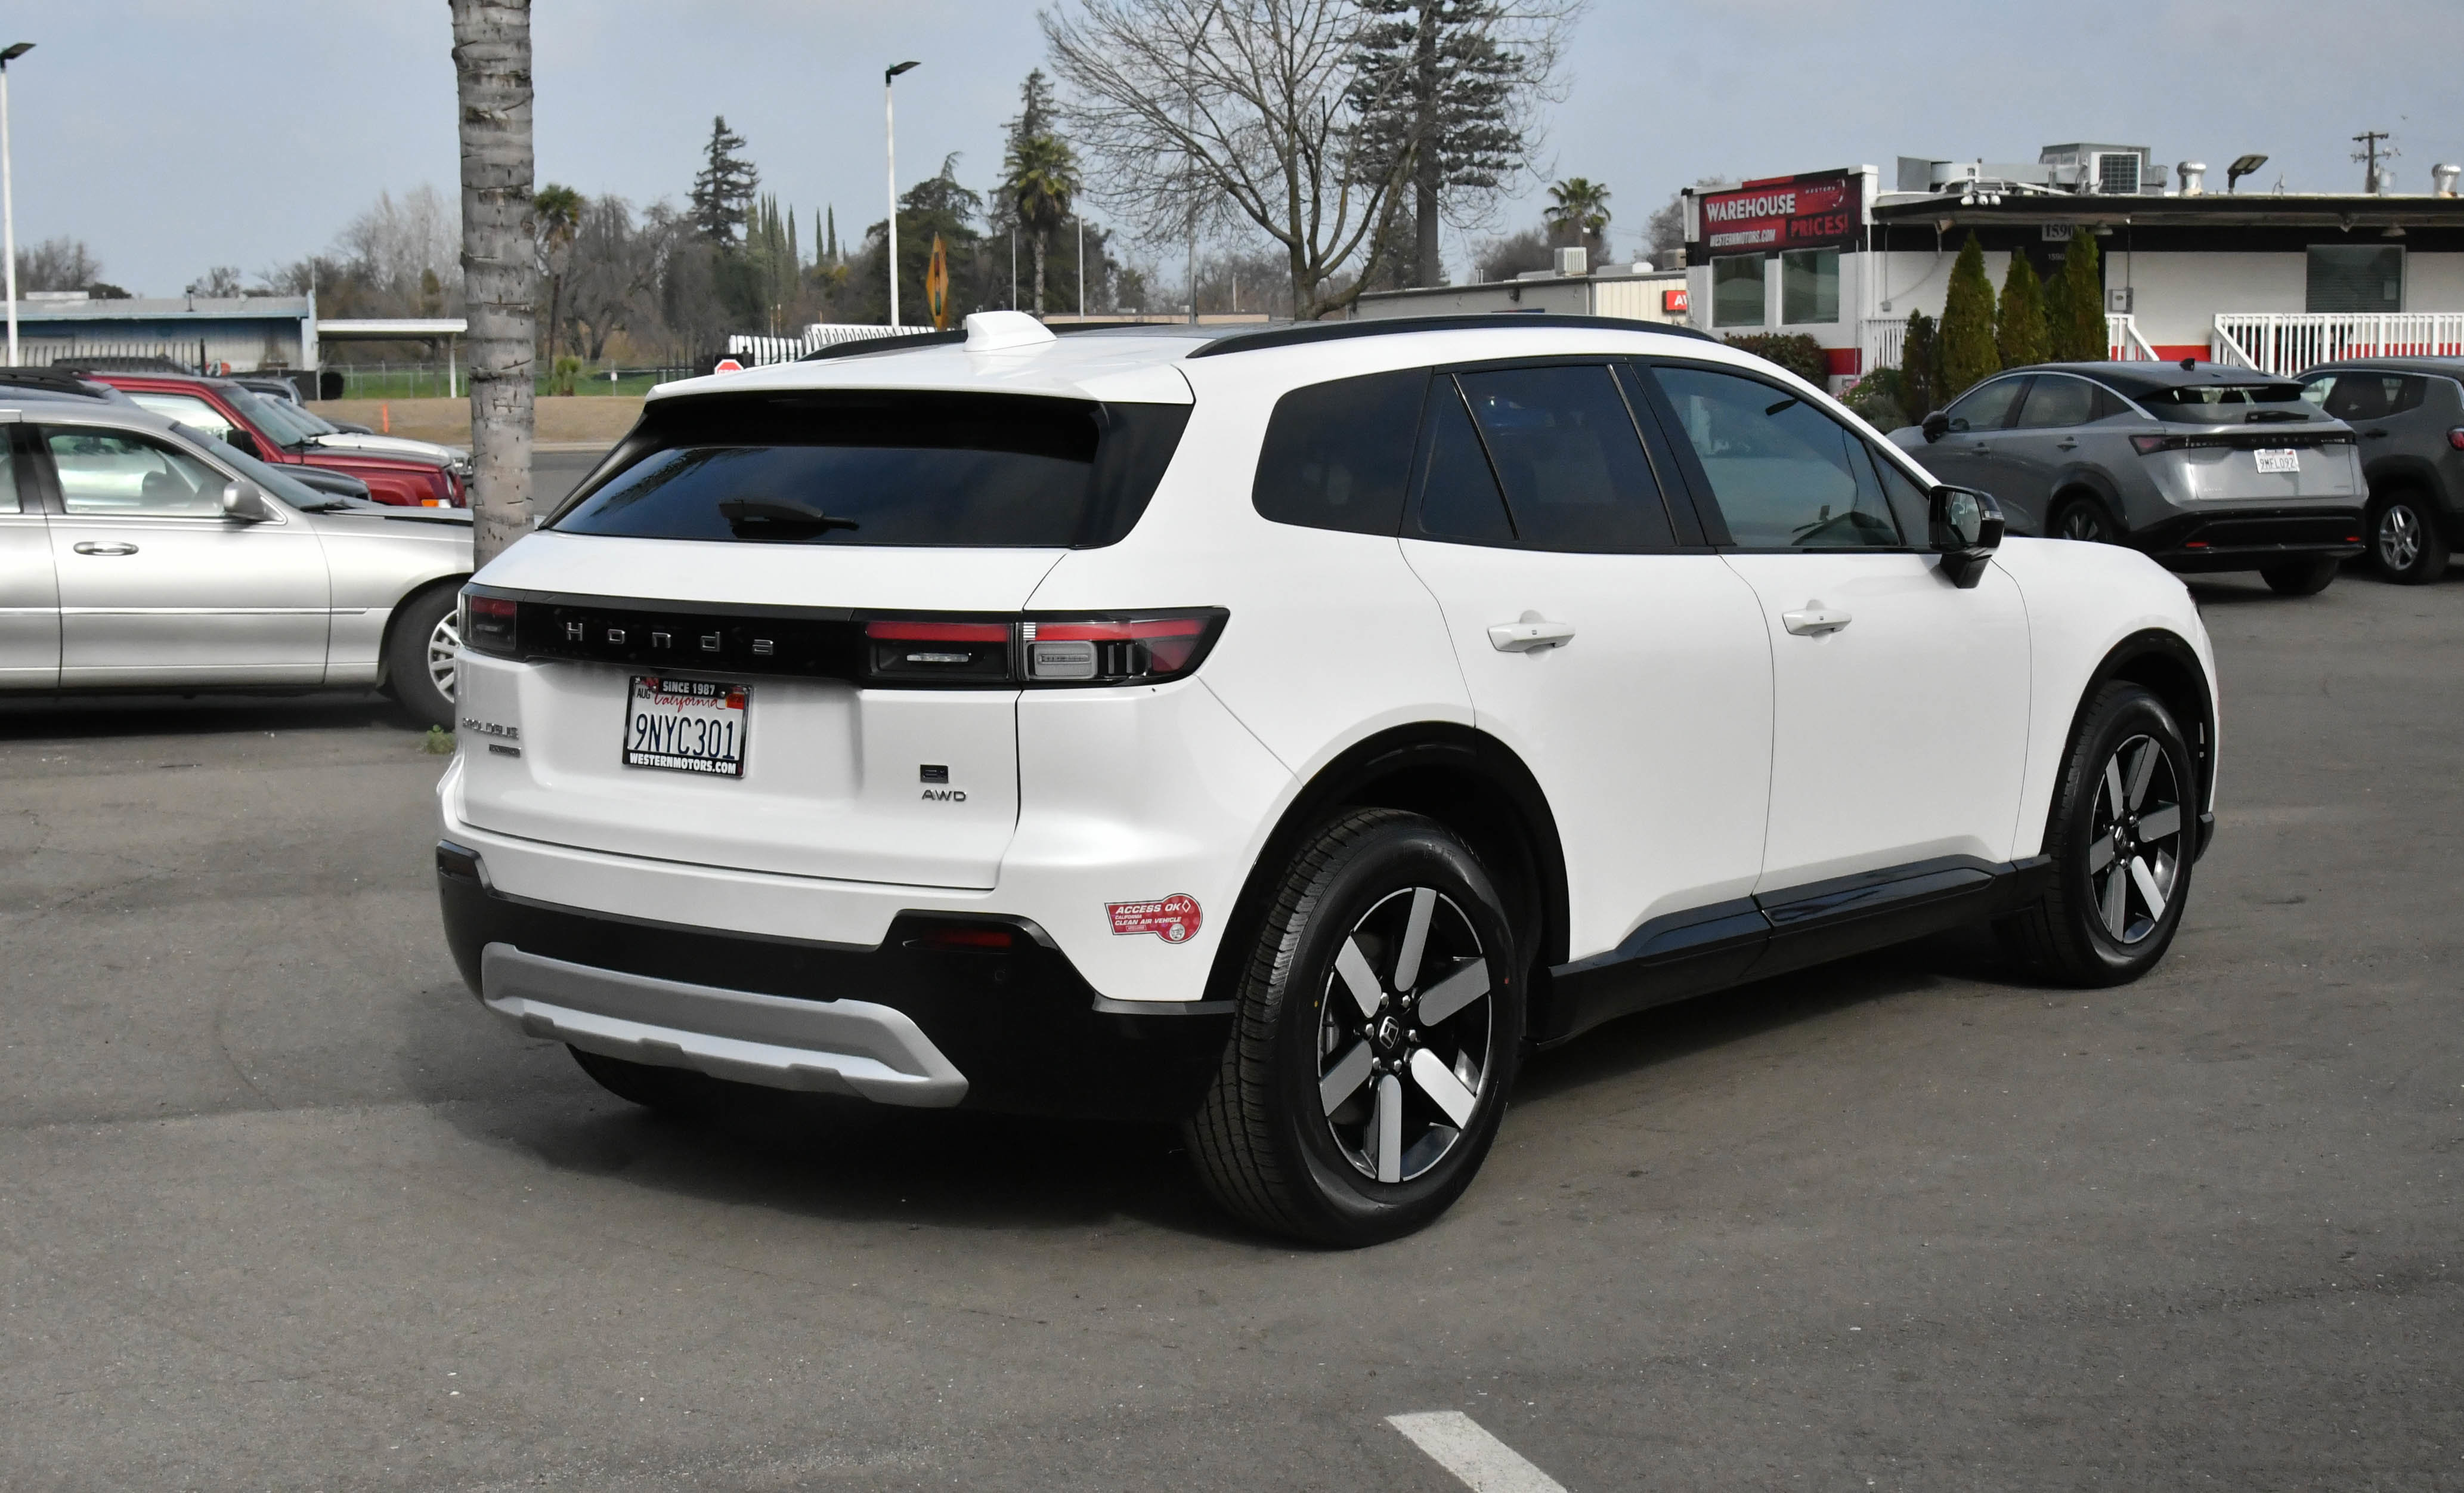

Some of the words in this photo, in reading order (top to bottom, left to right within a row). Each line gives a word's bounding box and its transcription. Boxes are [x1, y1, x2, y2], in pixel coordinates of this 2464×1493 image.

[1706, 193, 1796, 222] WAREHOUSE
[1791, 215, 1848, 237] PRICES!
[1710, 229, 1776, 248] WESTERNMOTORS.COM
[637, 688, 651, 699] AUG
[663, 681, 689, 693] SINCE
[693, 683, 716, 696] 1987
[654, 694, 726, 713] California
[634, 713, 735, 760] 9NYC301
[630, 752, 737, 774] WESTERNMOTORS.COM
[922, 789, 967, 802] AWD
[1115, 904, 1162, 914] ACCESS
[1165, 903, 1181, 911] OK
